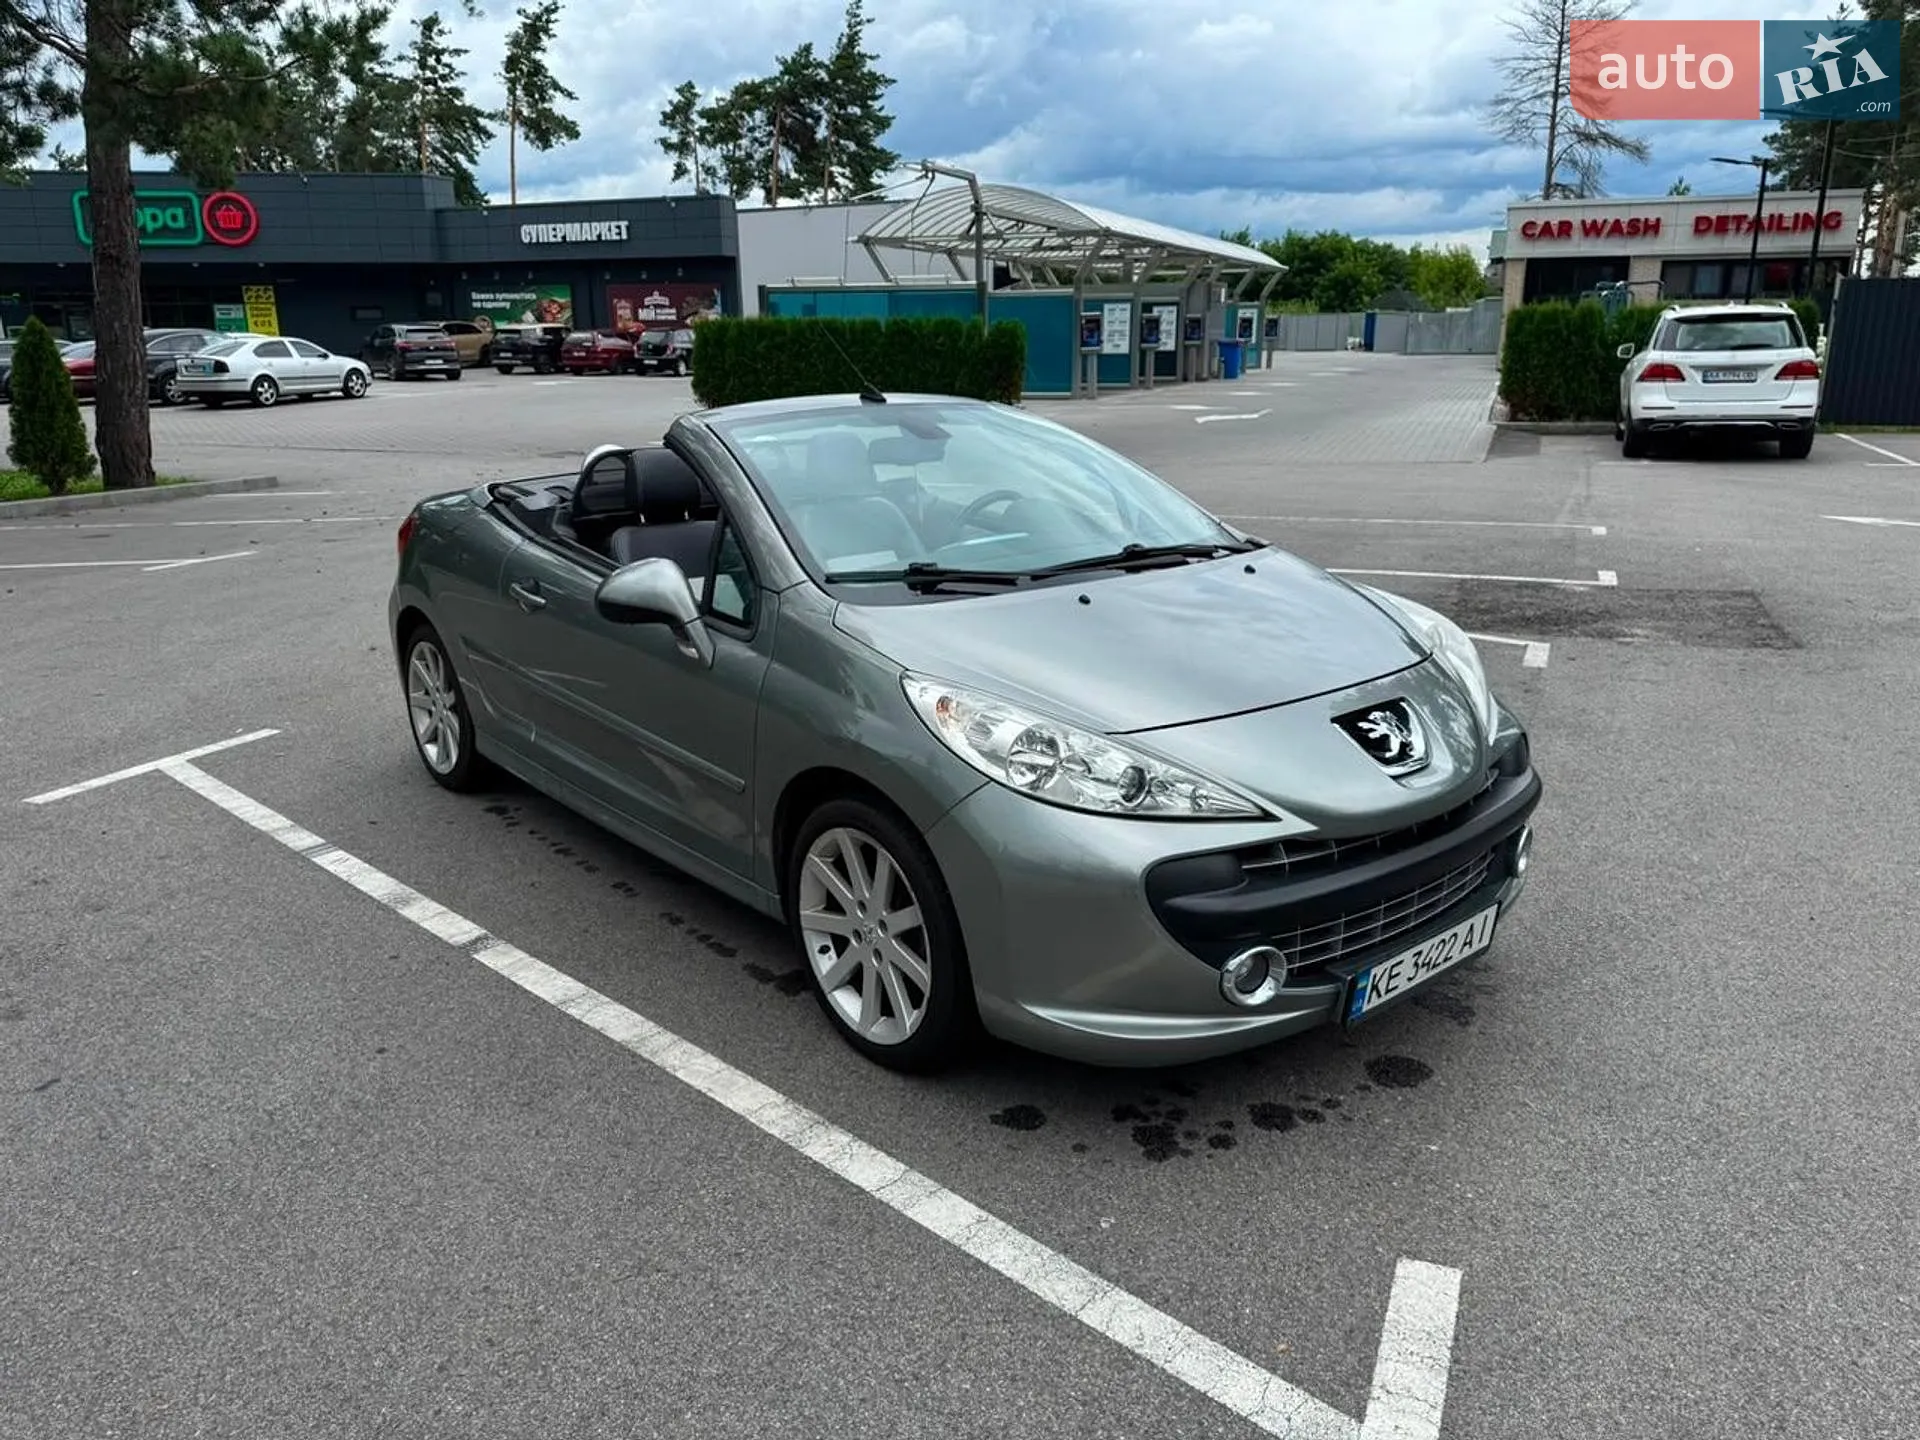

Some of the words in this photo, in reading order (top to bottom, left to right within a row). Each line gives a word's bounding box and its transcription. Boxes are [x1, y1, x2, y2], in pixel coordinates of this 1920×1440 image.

[521, 220, 629, 243] СУПЕРМАРКЕТ
[1521, 220, 1573, 240] CAR
[1581, 217, 1661, 239] WASH
[1693, 211, 1842, 235] DETAILING
[1367, 959, 1405, 1004] KE
[1407, 932, 1458, 983] 3422
[1460, 913, 1488, 954] AI
